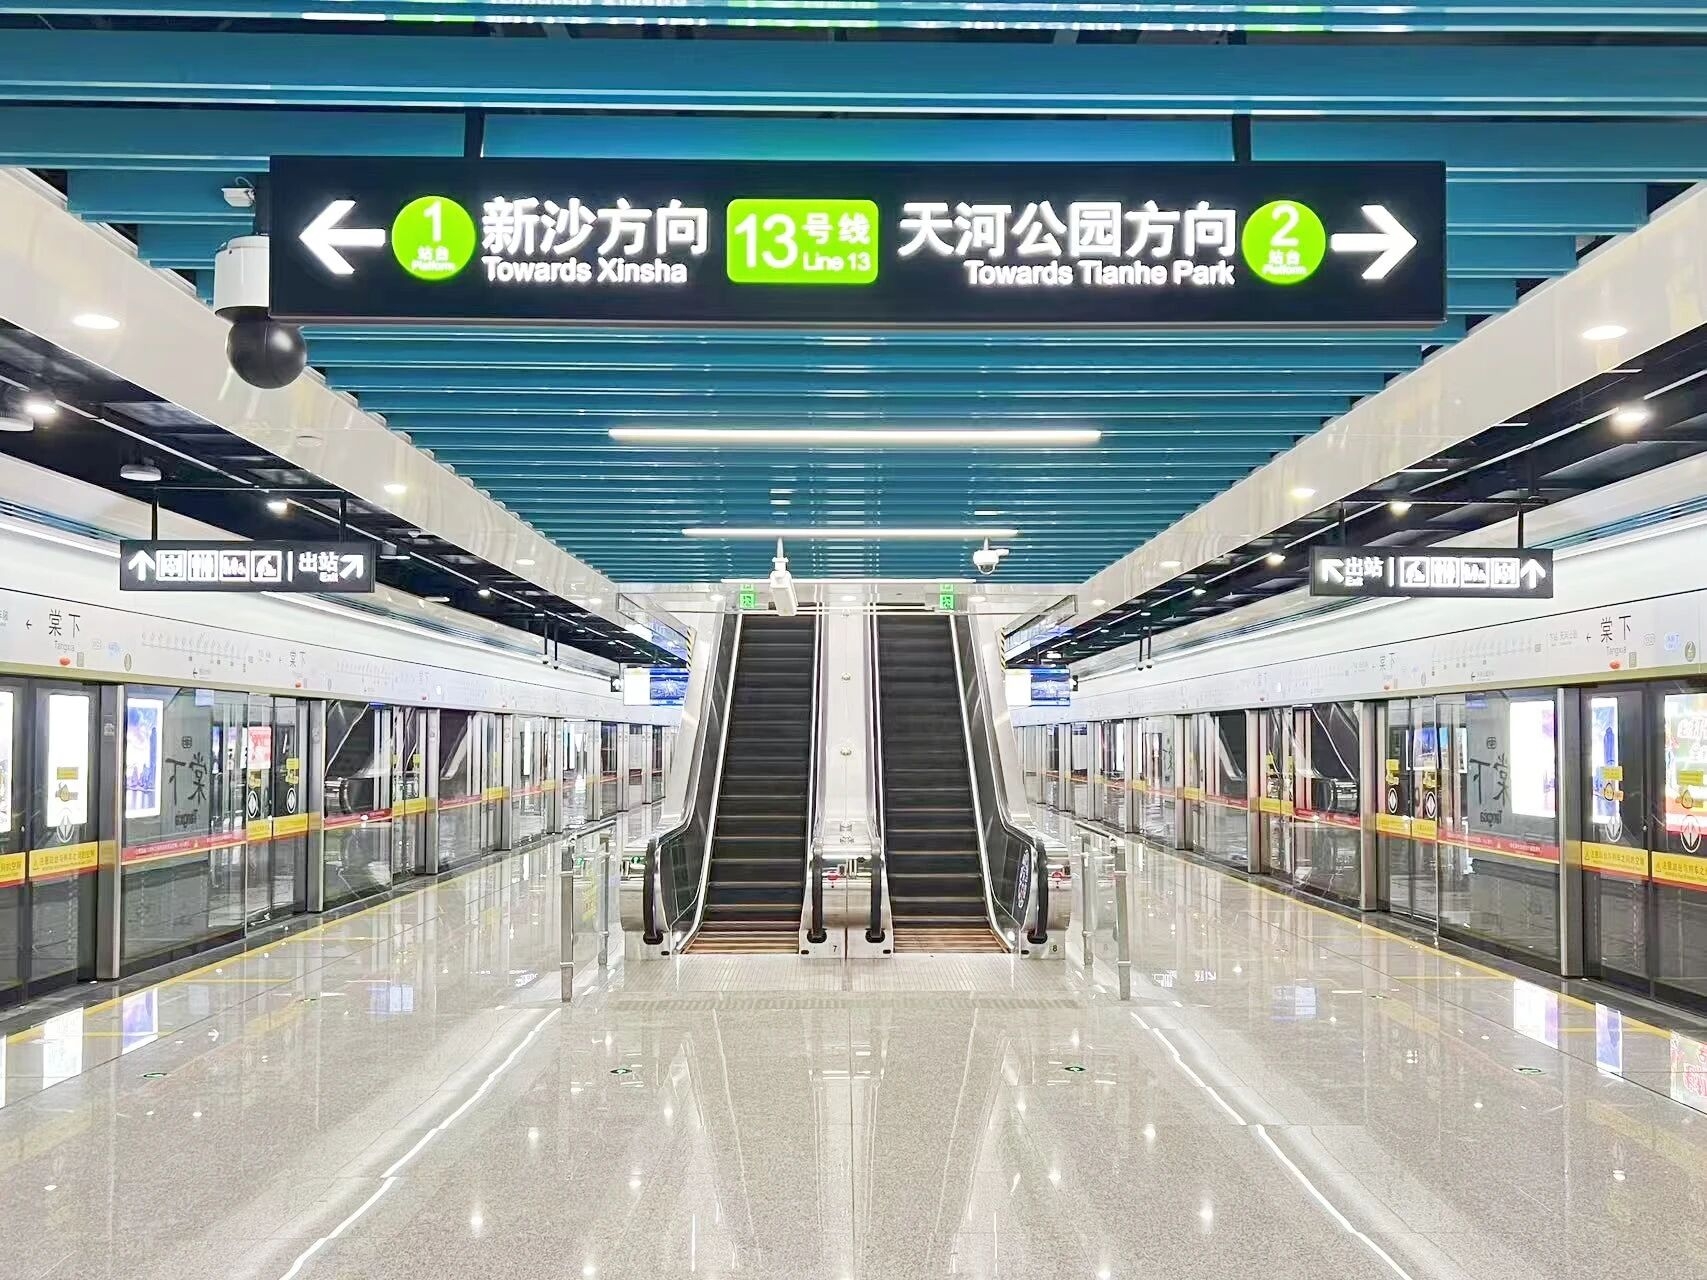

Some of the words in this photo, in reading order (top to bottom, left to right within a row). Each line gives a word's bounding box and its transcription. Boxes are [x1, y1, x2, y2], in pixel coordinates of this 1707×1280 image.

[424, 200, 442, 242] 1
[482, 197, 708, 256] 新沙方向
[898, 200, 1236, 256] 天河公园方向
[1270, 204, 1299, 247] 2
[482, 257, 592, 283] Towards
[597, 257, 688, 283] Xinsha
[803, 252, 844, 271] Line
[847, 252, 871, 271] 13
[964, 259, 1074, 286] Towards
[1078, 259, 1168, 286] Tianhe
[1172, 259, 1236, 286] Park
[298, 551, 339, 573] 出站
[1345, 556, 1384, 577] 出站
[48, 608, 81, 638] 棠下
[1600, 615, 1631, 643] 棠下
